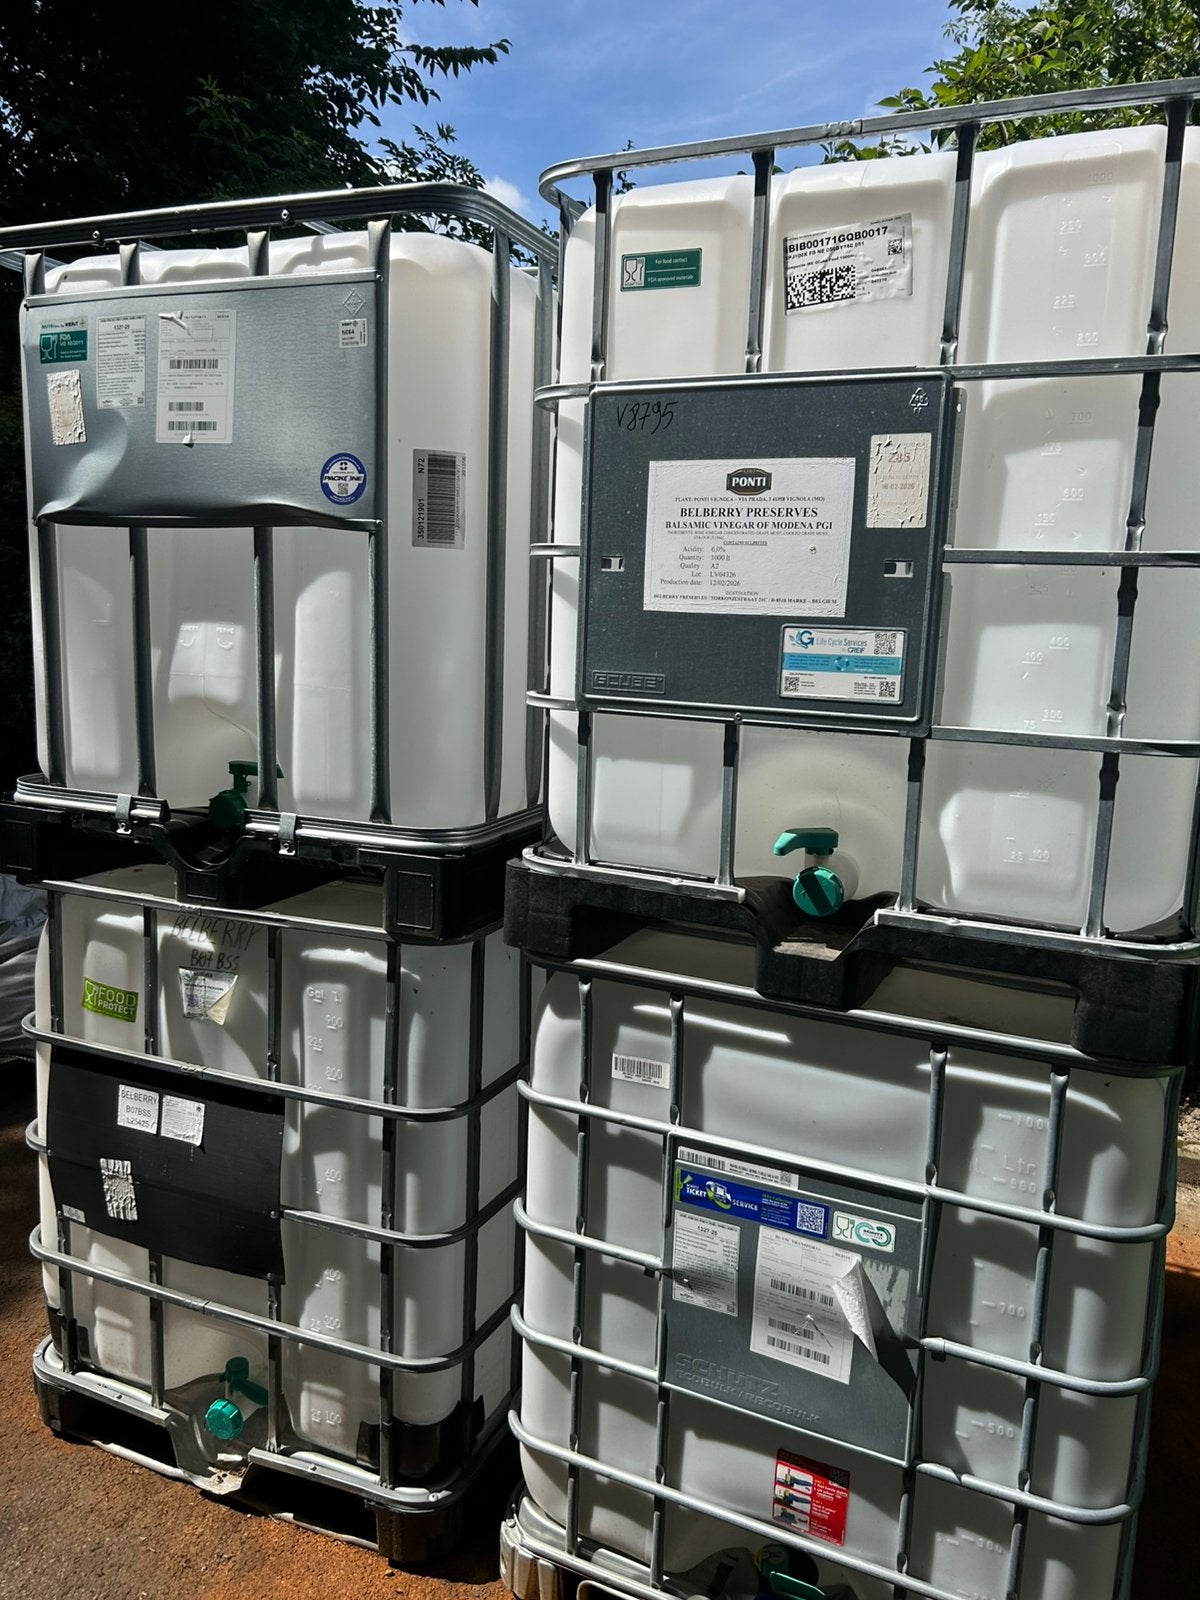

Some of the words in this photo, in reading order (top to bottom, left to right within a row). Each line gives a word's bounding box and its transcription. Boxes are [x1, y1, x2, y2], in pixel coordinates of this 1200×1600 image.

[617, 401, 679, 435] V8795
[731, 476, 767, 487] PONTI
[680, 507, 743, 518] BELBERRY
[747, 507, 818, 518] PRESERVES
[665, 521, 712, 529] BALSAMIC
[713, 521, 755, 529] VINEGAR
[757, 521, 770, 529] OF
[772, 521, 814, 530] MODENA
[816, 521, 833, 530] PGI
[690, 578, 703, 586] date:
[828, 637, 843, 647] Cycle
[843, 638, 868, 647] Services
[171, 914, 264, 951] BELBERRY
[99, 986, 136, 1007] FOOD
[98, 1000, 135, 1015] PROTECT
[121, 1089, 158, 1105] BELBERRY
[1017, 1114, 1050, 1130] 100
[686, 1187, 707, 1198] TICKET
[732, 1199, 759, 1212] SERVICE
[988, 1422, 1014, 1438] 500
